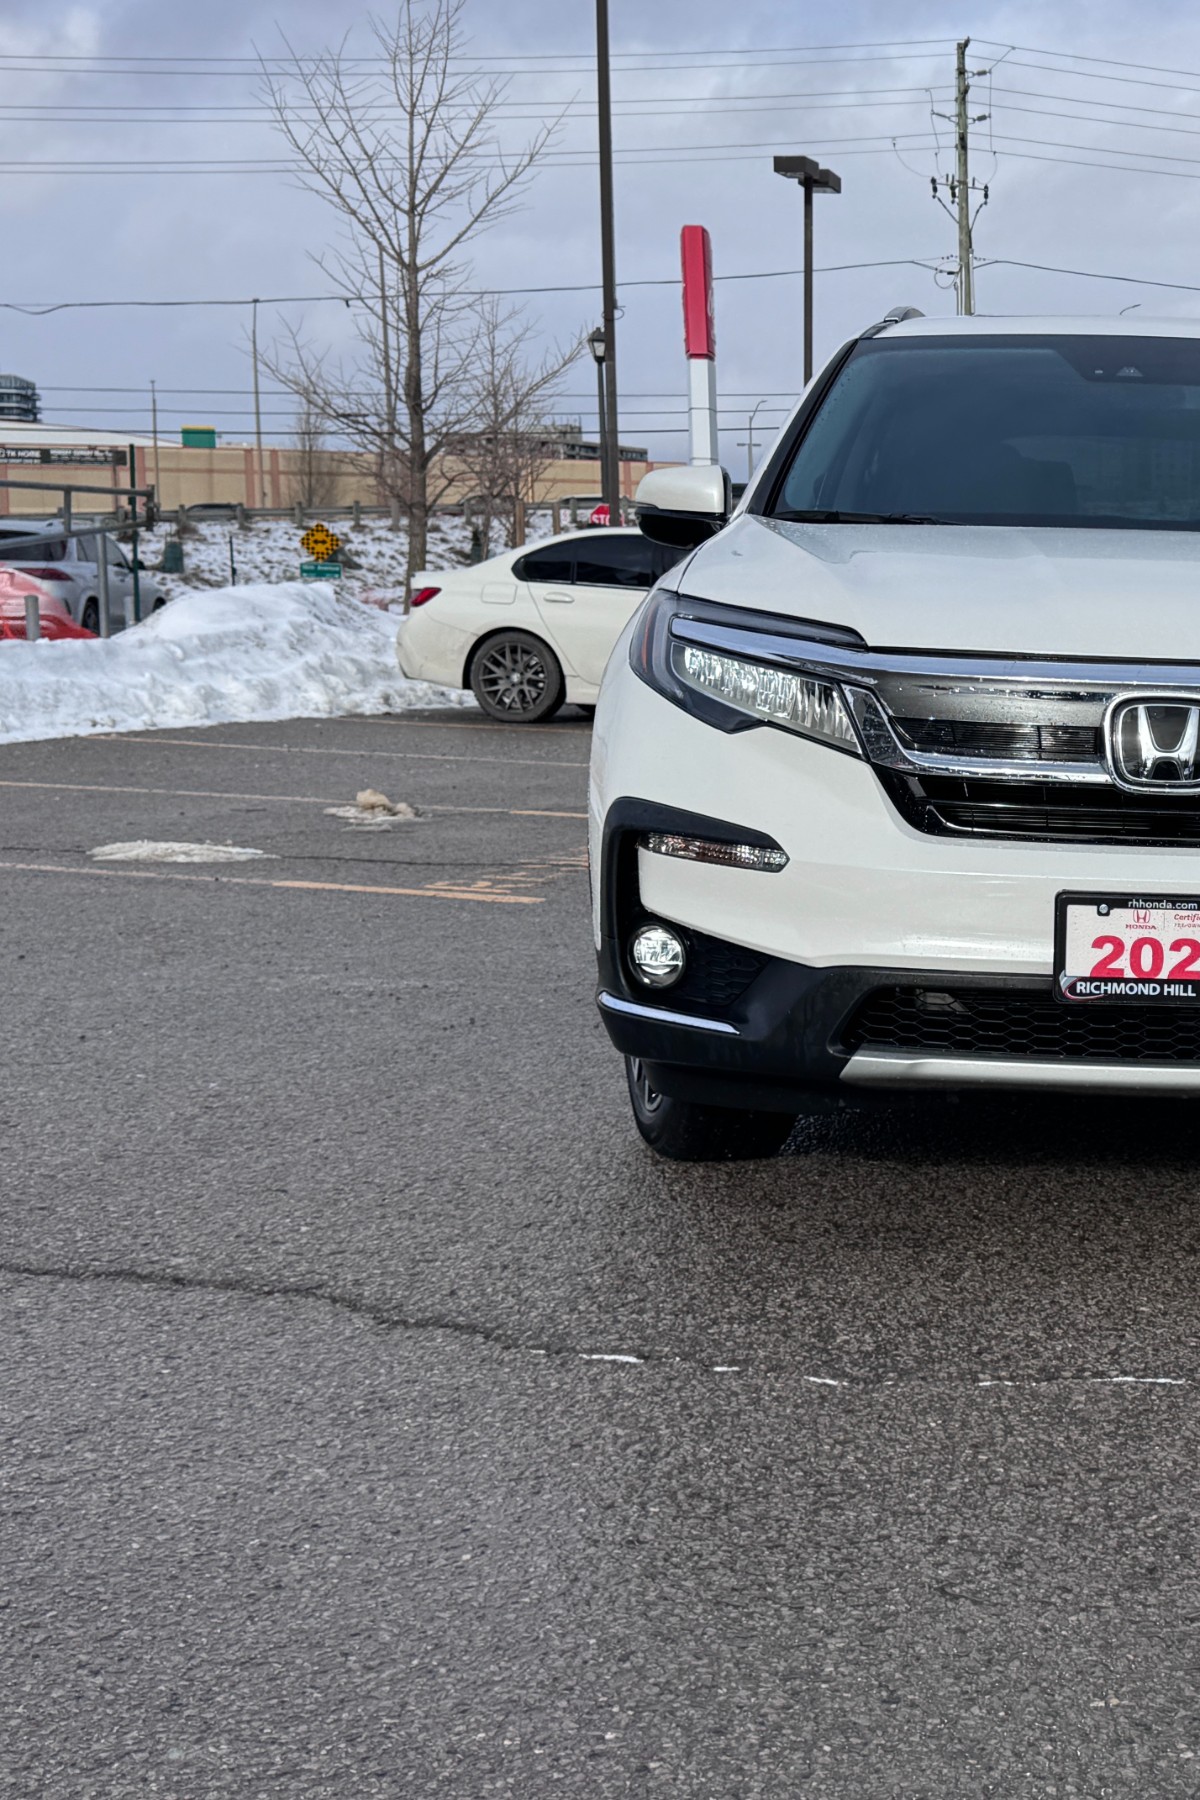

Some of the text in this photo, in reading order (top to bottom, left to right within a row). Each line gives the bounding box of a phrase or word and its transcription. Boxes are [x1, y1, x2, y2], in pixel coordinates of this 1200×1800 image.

[1128, 898, 1198, 910] rhhonda.com
[1076, 981, 1161, 996] RICHMOND
[1163, 983, 1197, 997] HILL
